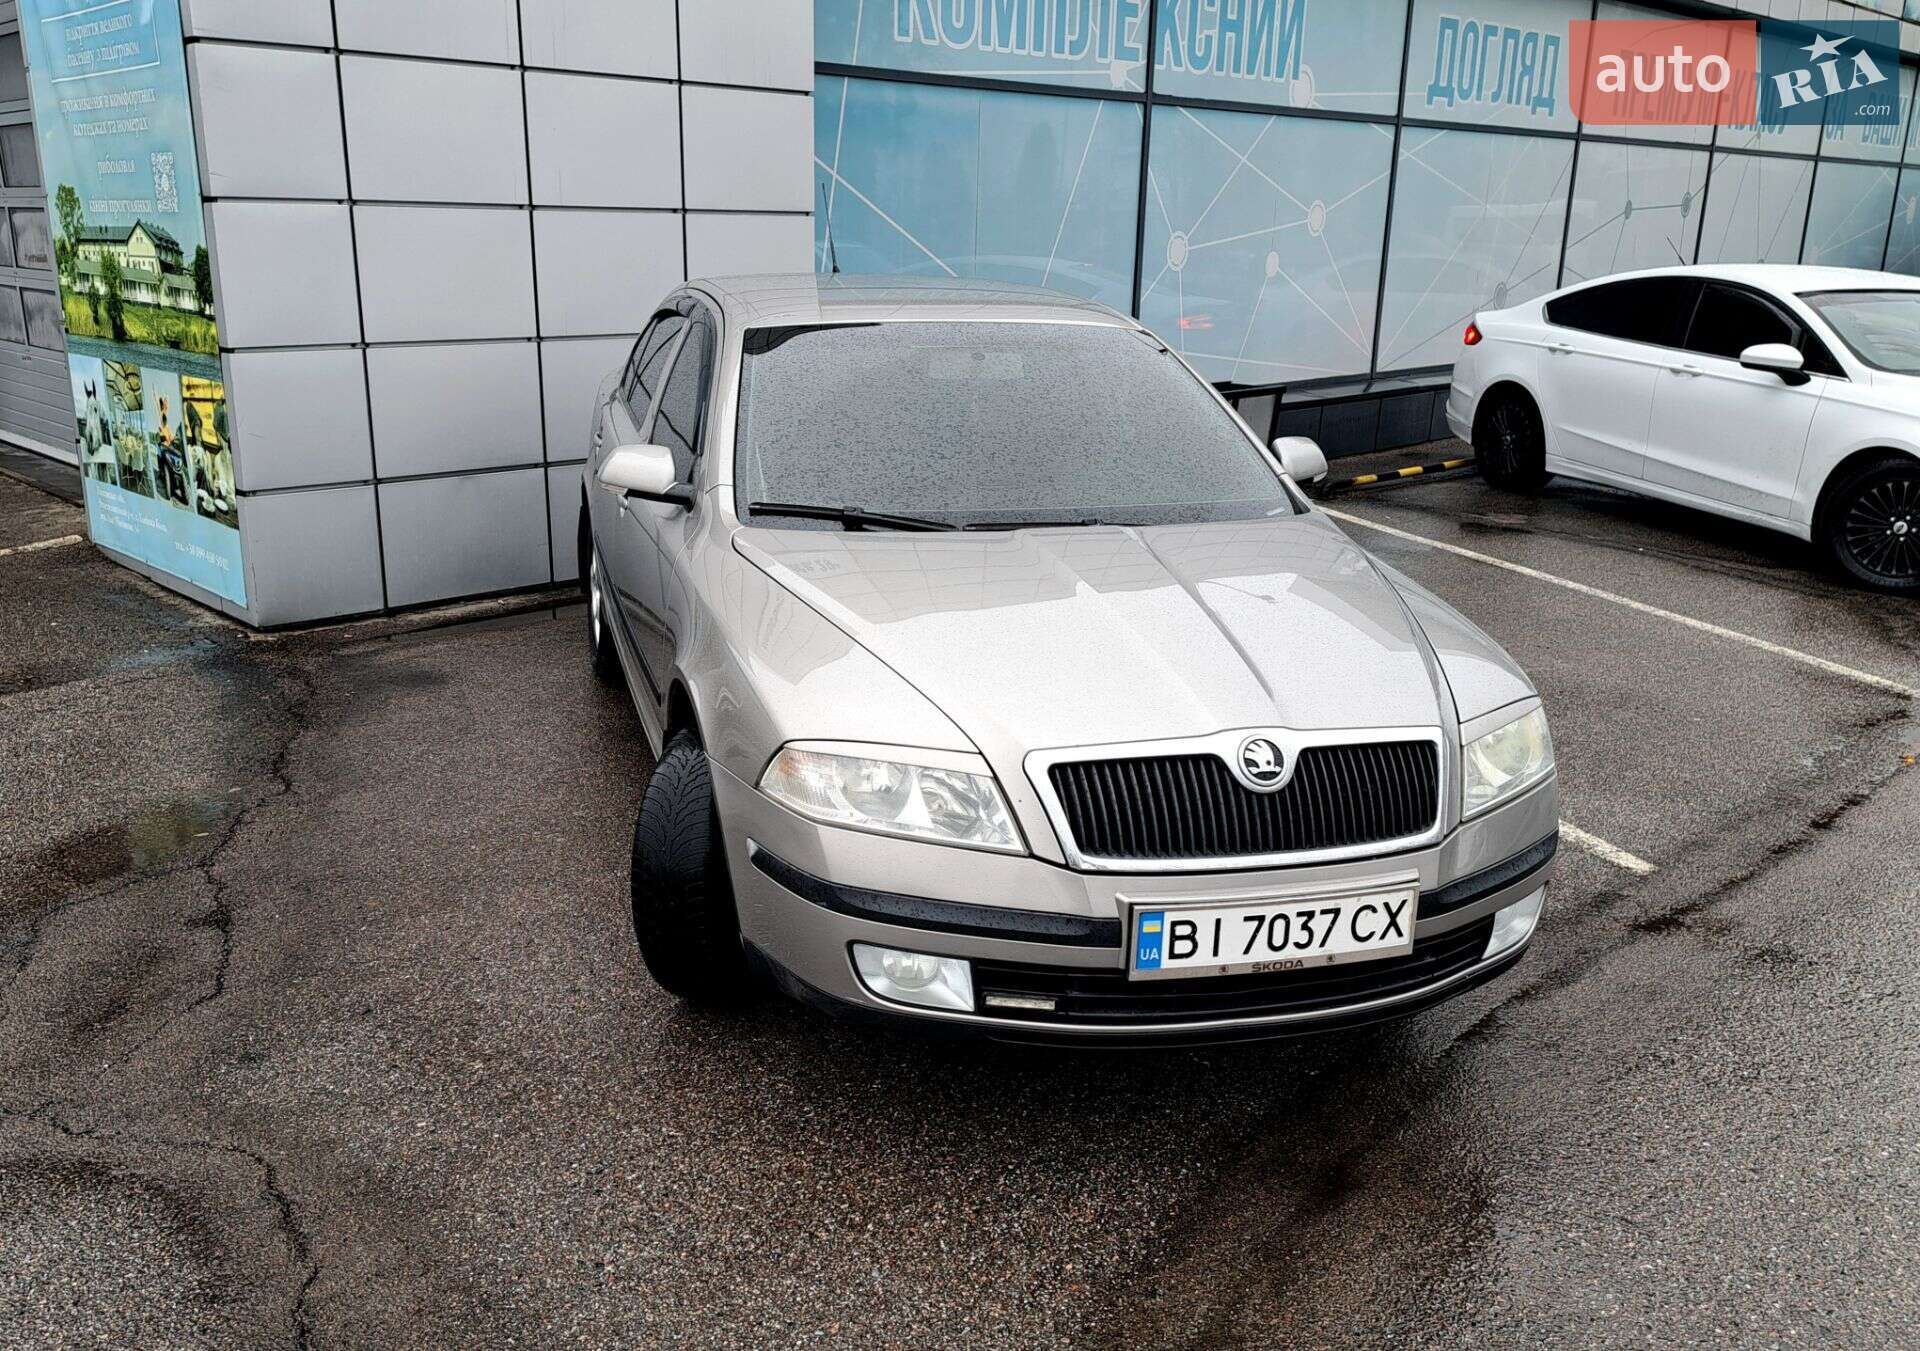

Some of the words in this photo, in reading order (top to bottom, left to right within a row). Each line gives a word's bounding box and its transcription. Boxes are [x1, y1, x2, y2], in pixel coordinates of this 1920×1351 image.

[1425, 16, 1561, 117] ДОГЛЯД
[1140, 948, 1159, 960] UA
[1168, 918, 1221, 960] BI
[1242, 907, 1341, 955] 7037
[1350, 899, 1408, 943] CX
